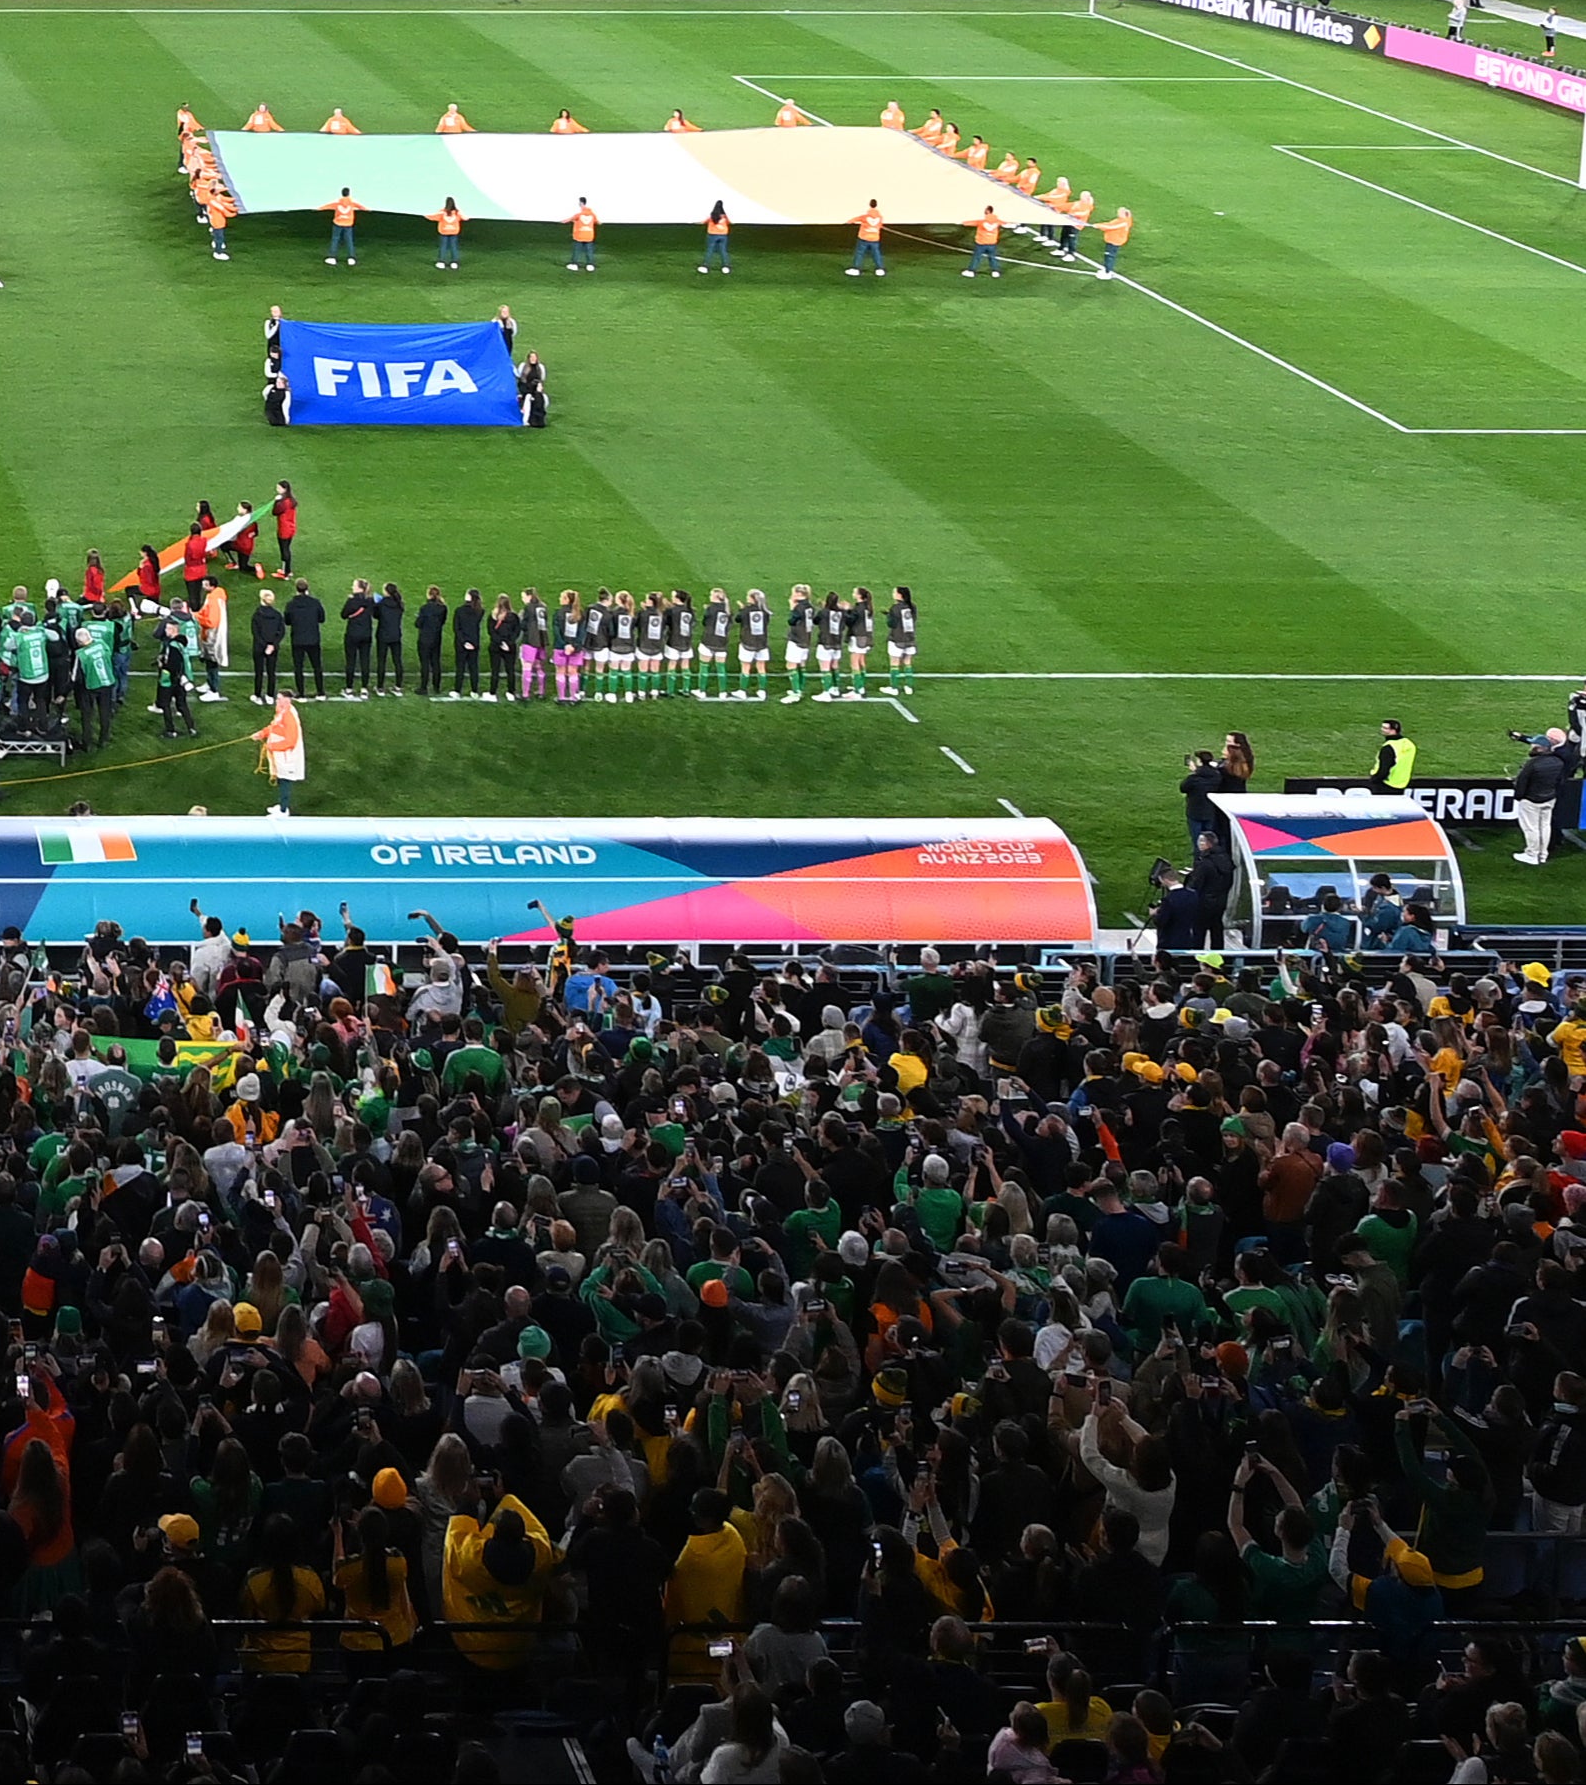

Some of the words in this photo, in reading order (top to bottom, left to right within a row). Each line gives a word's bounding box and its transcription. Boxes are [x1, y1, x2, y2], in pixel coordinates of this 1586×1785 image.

[1294, 5, 1354, 46] Mates
[1475, 53, 1553, 99] BEYOND
[312, 356, 479, 398] FIFA
[370, 845, 422, 865] OF
[431, 845, 597, 865] IRELAND
[923, 842, 995, 854] WORLD
[997, 842, 1036, 853] CUP
